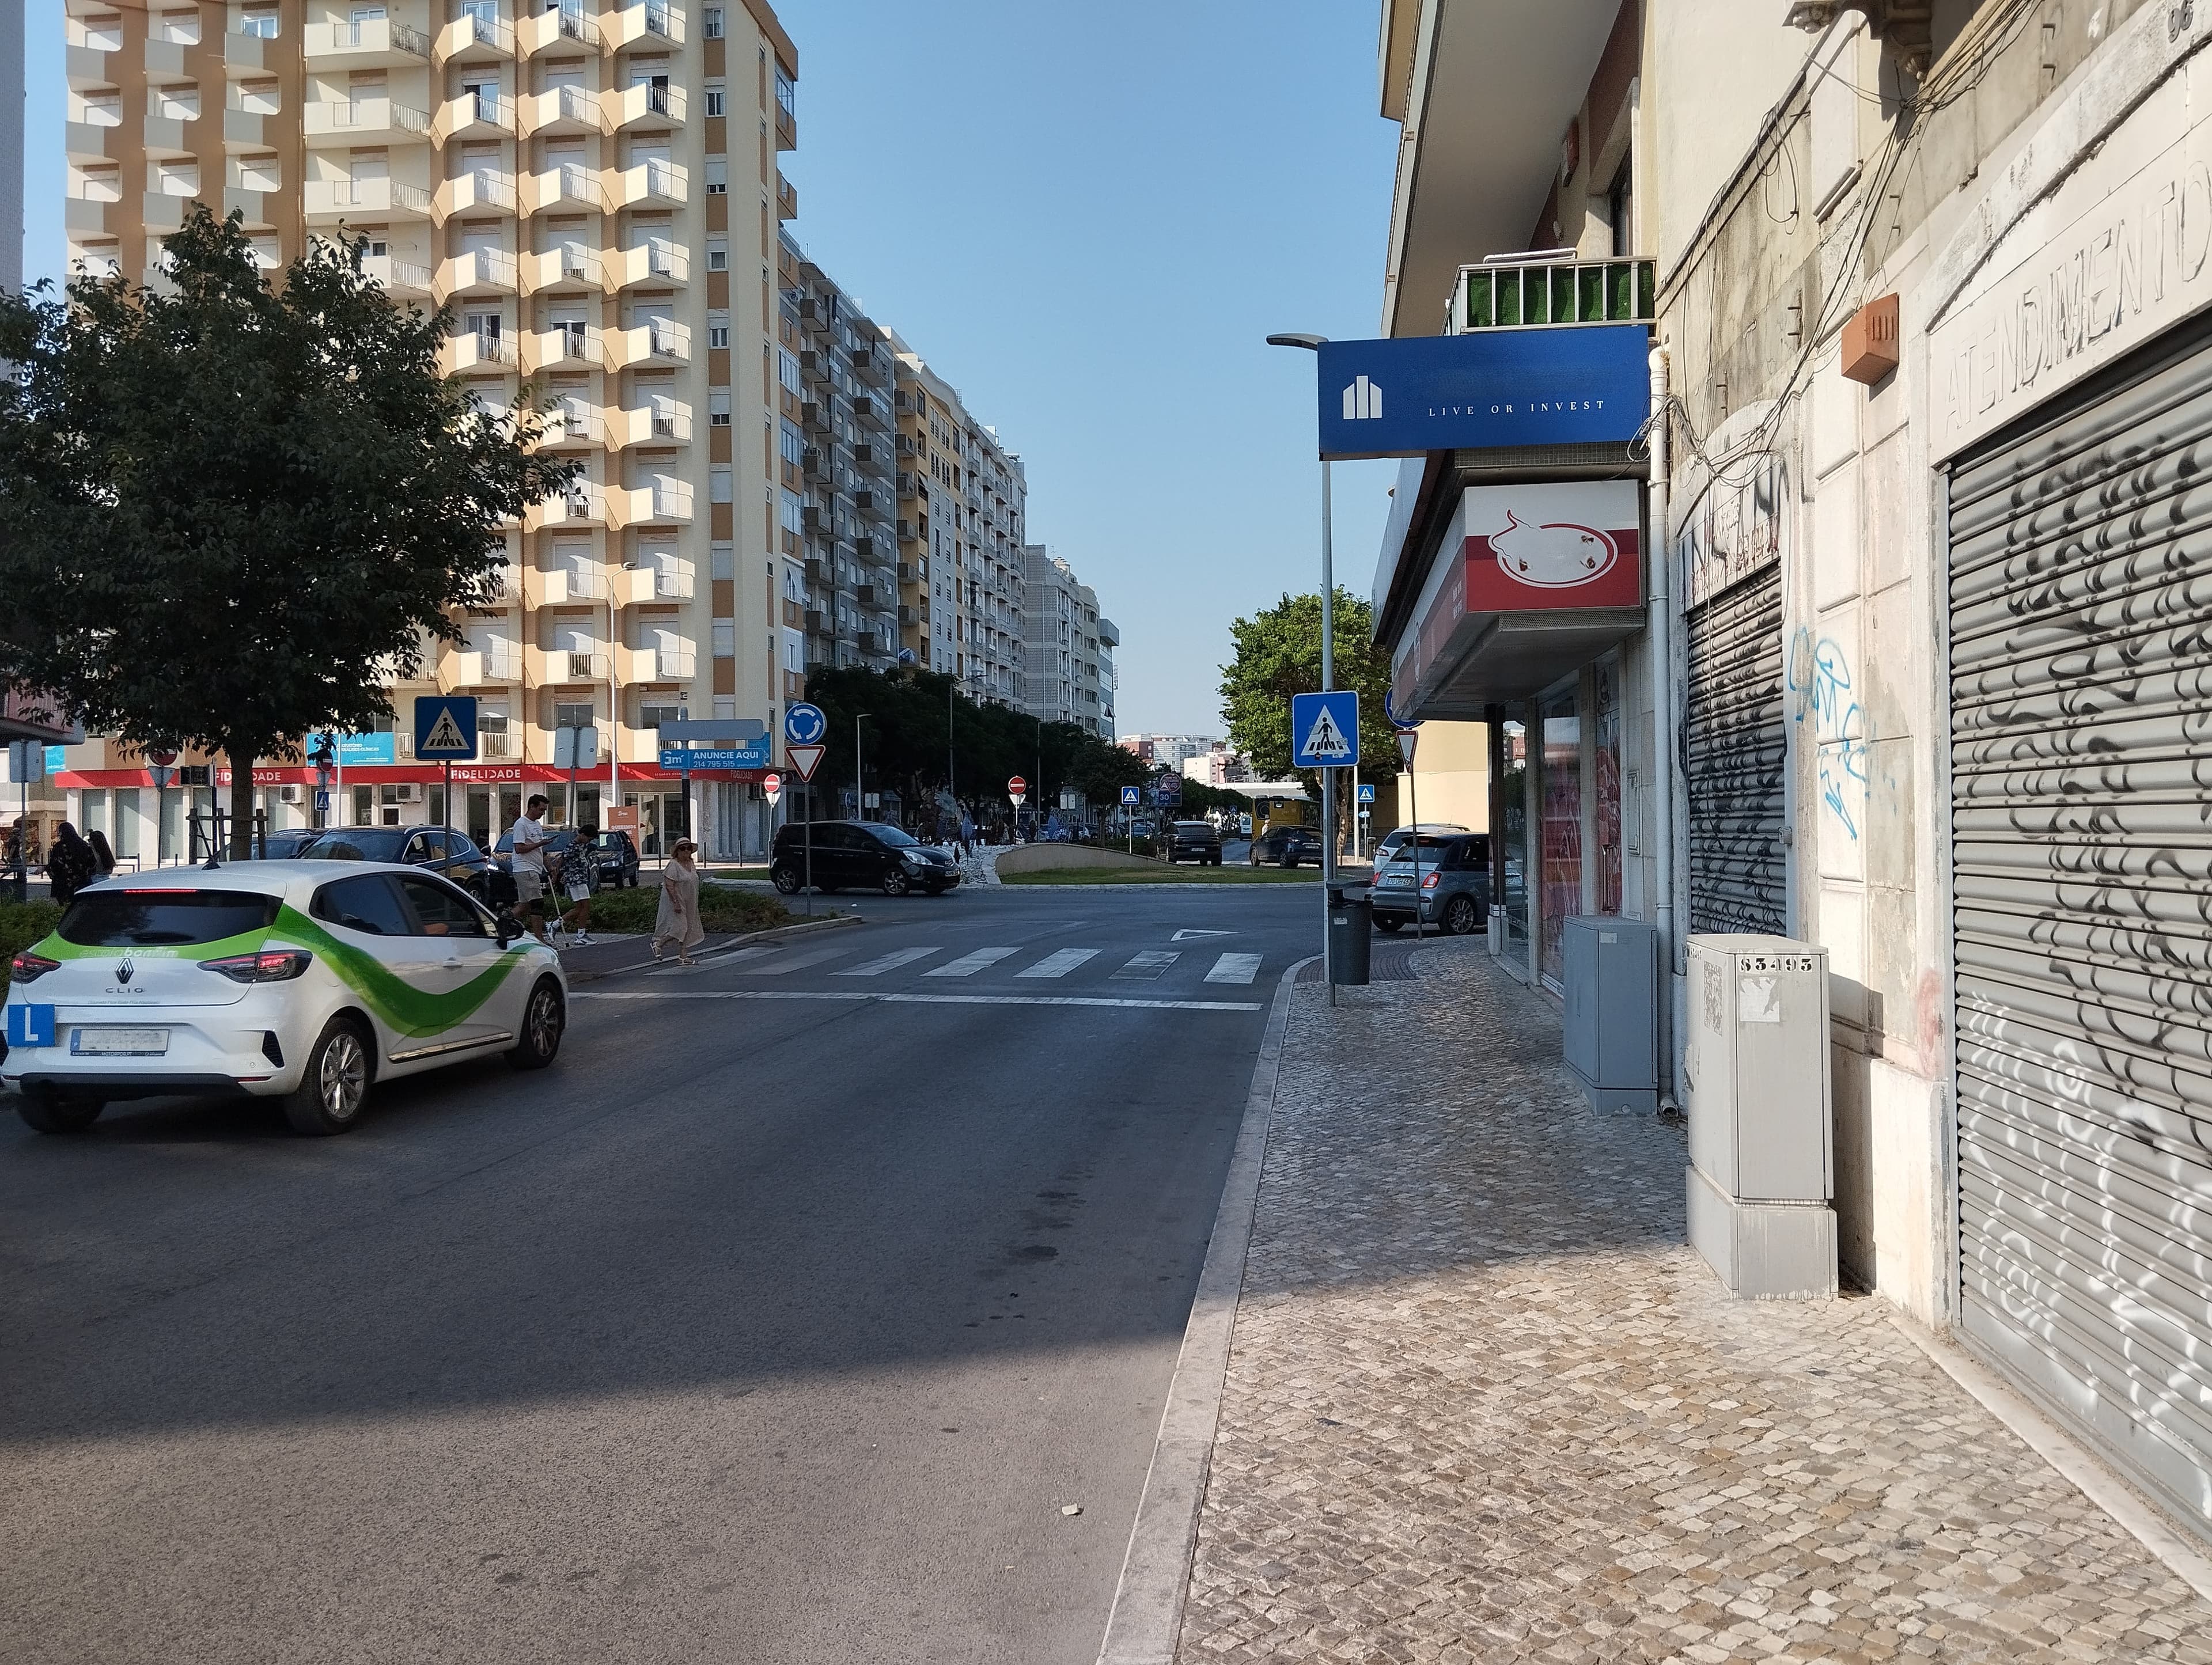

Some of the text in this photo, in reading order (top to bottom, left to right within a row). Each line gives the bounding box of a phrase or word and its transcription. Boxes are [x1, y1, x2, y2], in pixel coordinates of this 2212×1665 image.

[2168, 0, 2194, 44] 96
[1945, 160, 2212, 438] ATENDIMENTO
[1429, 400, 1604, 416] LIVE OR INVEST
[693, 751, 734, 759] ANUNCIE
[736, 750, 759, 759] AQUI
[451, 769, 521, 779] FIDELIDADE
[25, 1007, 39, 1041] L
